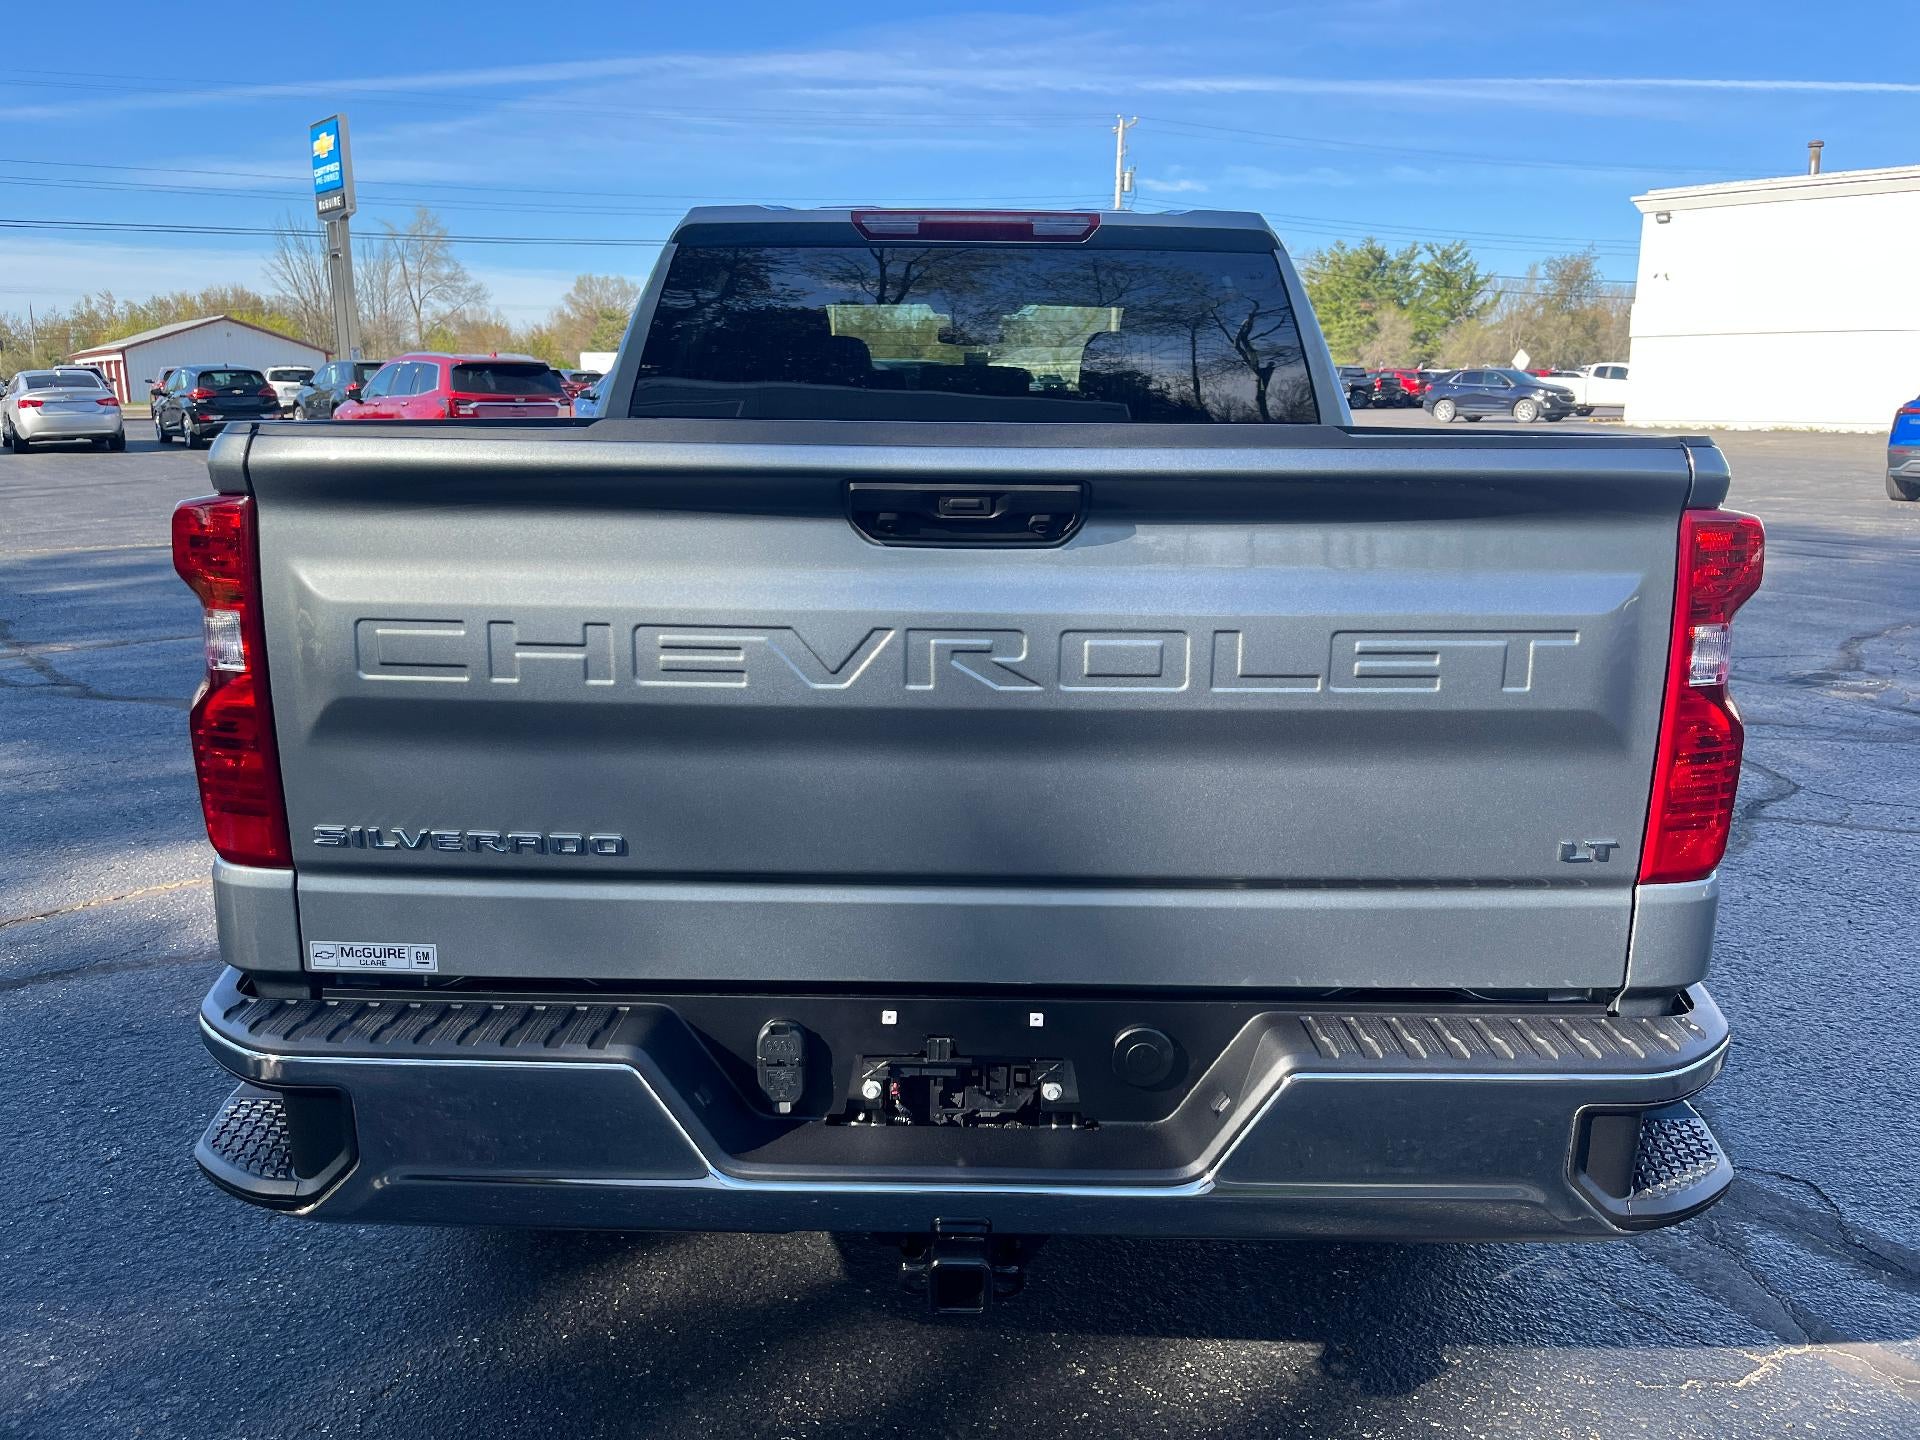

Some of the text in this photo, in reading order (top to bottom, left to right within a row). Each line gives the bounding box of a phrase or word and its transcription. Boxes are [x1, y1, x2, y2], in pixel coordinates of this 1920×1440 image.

[354, 617, 1583, 694] CHEVROLET
[312, 824, 628, 856] SILVERADO
[1558, 839, 1619, 863] LT
[340, 946, 406, 959] McGUIRE
[415, 951, 430, 961] GM
[359, 959, 387, 967] CLARE
